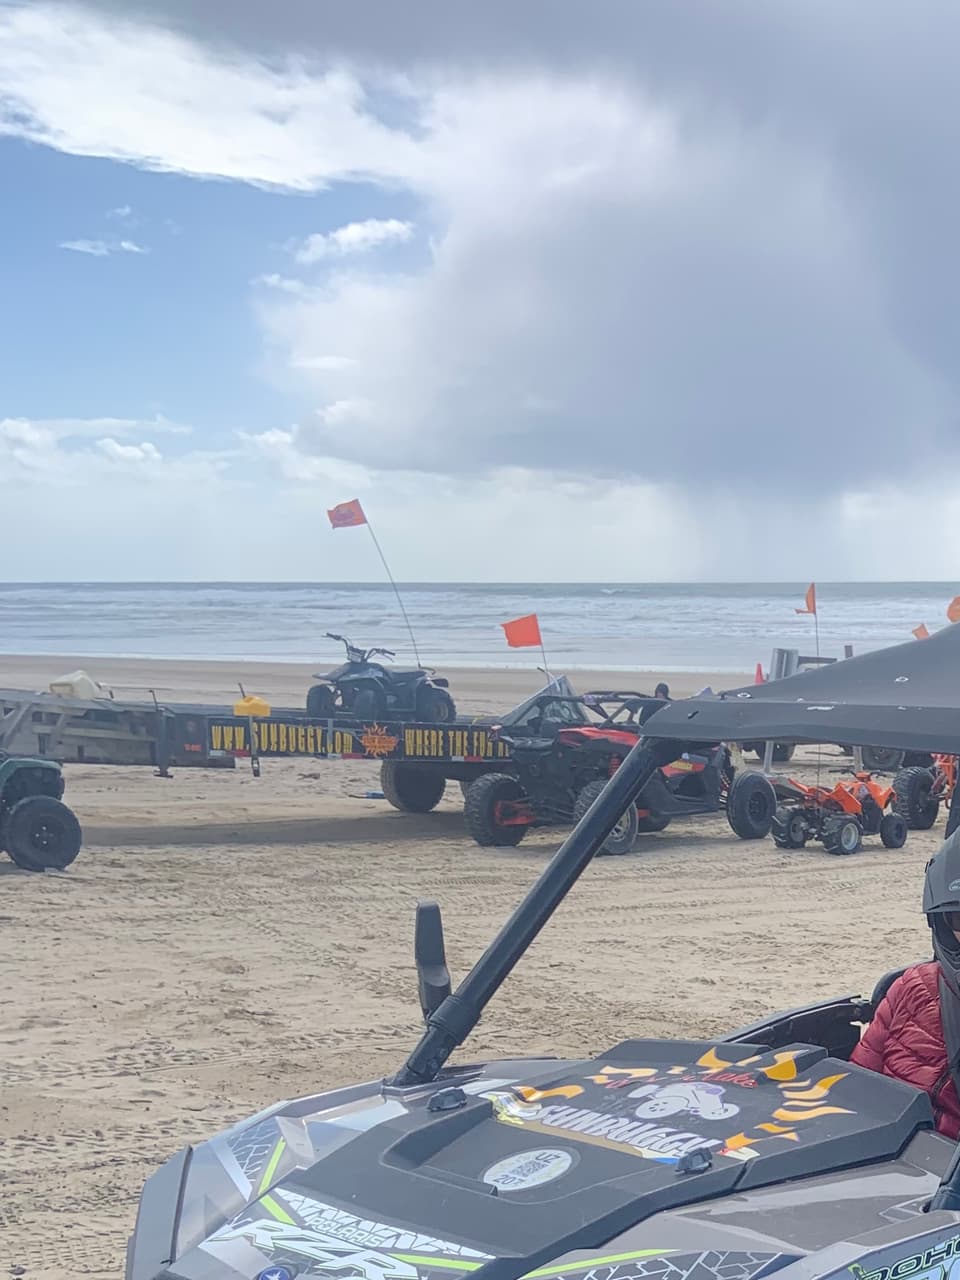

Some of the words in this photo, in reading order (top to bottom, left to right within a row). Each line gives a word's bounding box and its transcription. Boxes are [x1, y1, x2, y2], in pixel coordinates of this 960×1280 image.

[405, 729, 443, 757] WHERE
[449, 730, 468, 757] THE
[536, 1152, 561, 1164] UZ
[304, 1213, 387, 1248] POLARIS
